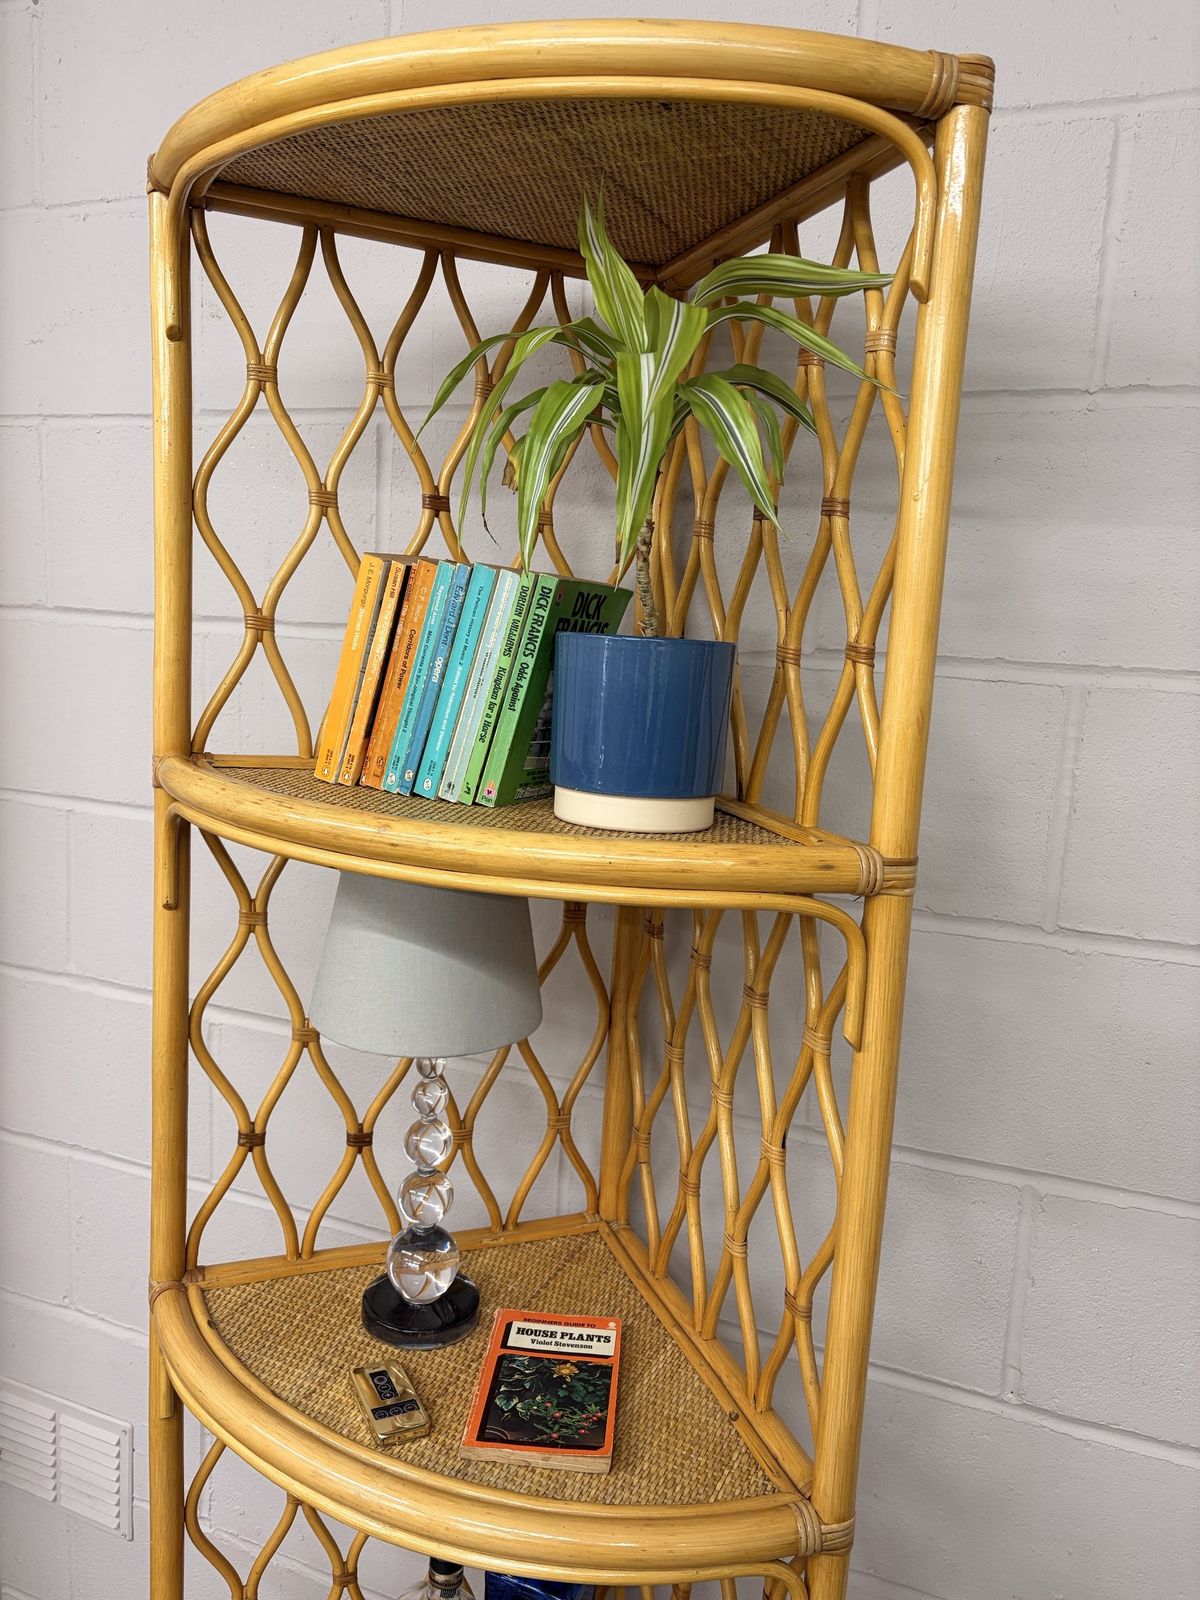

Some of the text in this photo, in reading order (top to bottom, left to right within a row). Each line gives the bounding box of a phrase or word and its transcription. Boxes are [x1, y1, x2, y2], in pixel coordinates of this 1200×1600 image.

[391, 566, 401, 587] Susan
[359, 575, 372, 608] Morpurgo
[388, 587, 396, 598] Hill
[432, 584, 444, 611] Raymond
[448, 584, 463, 617] Edward
[476, 584, 484, 596] The
[513, 584, 529, 617] DORIAN
[412, 603, 423, 623] Snow
[471, 596, 481, 617] Pelican
[570, 591, 608, 621] DICK
[429, 611, 437, 625] Aron
[464, 617, 475, 637] History
[403, 628, 416, 660] Corridors
[441, 625, 453, 645] Dent
[502, 618, 520, 657] WILLIAMS
[418, 644, 429, 667] Currents
[459, 644, 468, 661] Music
[505, 585, 553, 711] DICK FRANCIS Odds Against
[401, 660, 408, 668] of
[430, 655, 444, 683] opera
[396, 668, 406, 690] Power
[453, 666, 462, 684] Edited
[489, 665, 507, 700] Kingdom
[402, 706, 412, 728] Thought
[486, 701, 497, 713] for
[440, 719, 448, 730] and
[478, 719, 492, 743] Horse
[523, 1317, 562, 1326] BEGINNERS
[516, 1327, 612, 1344] HOUSE PLANTS
[531, 1338, 593, 1350] Violet Stevenson
